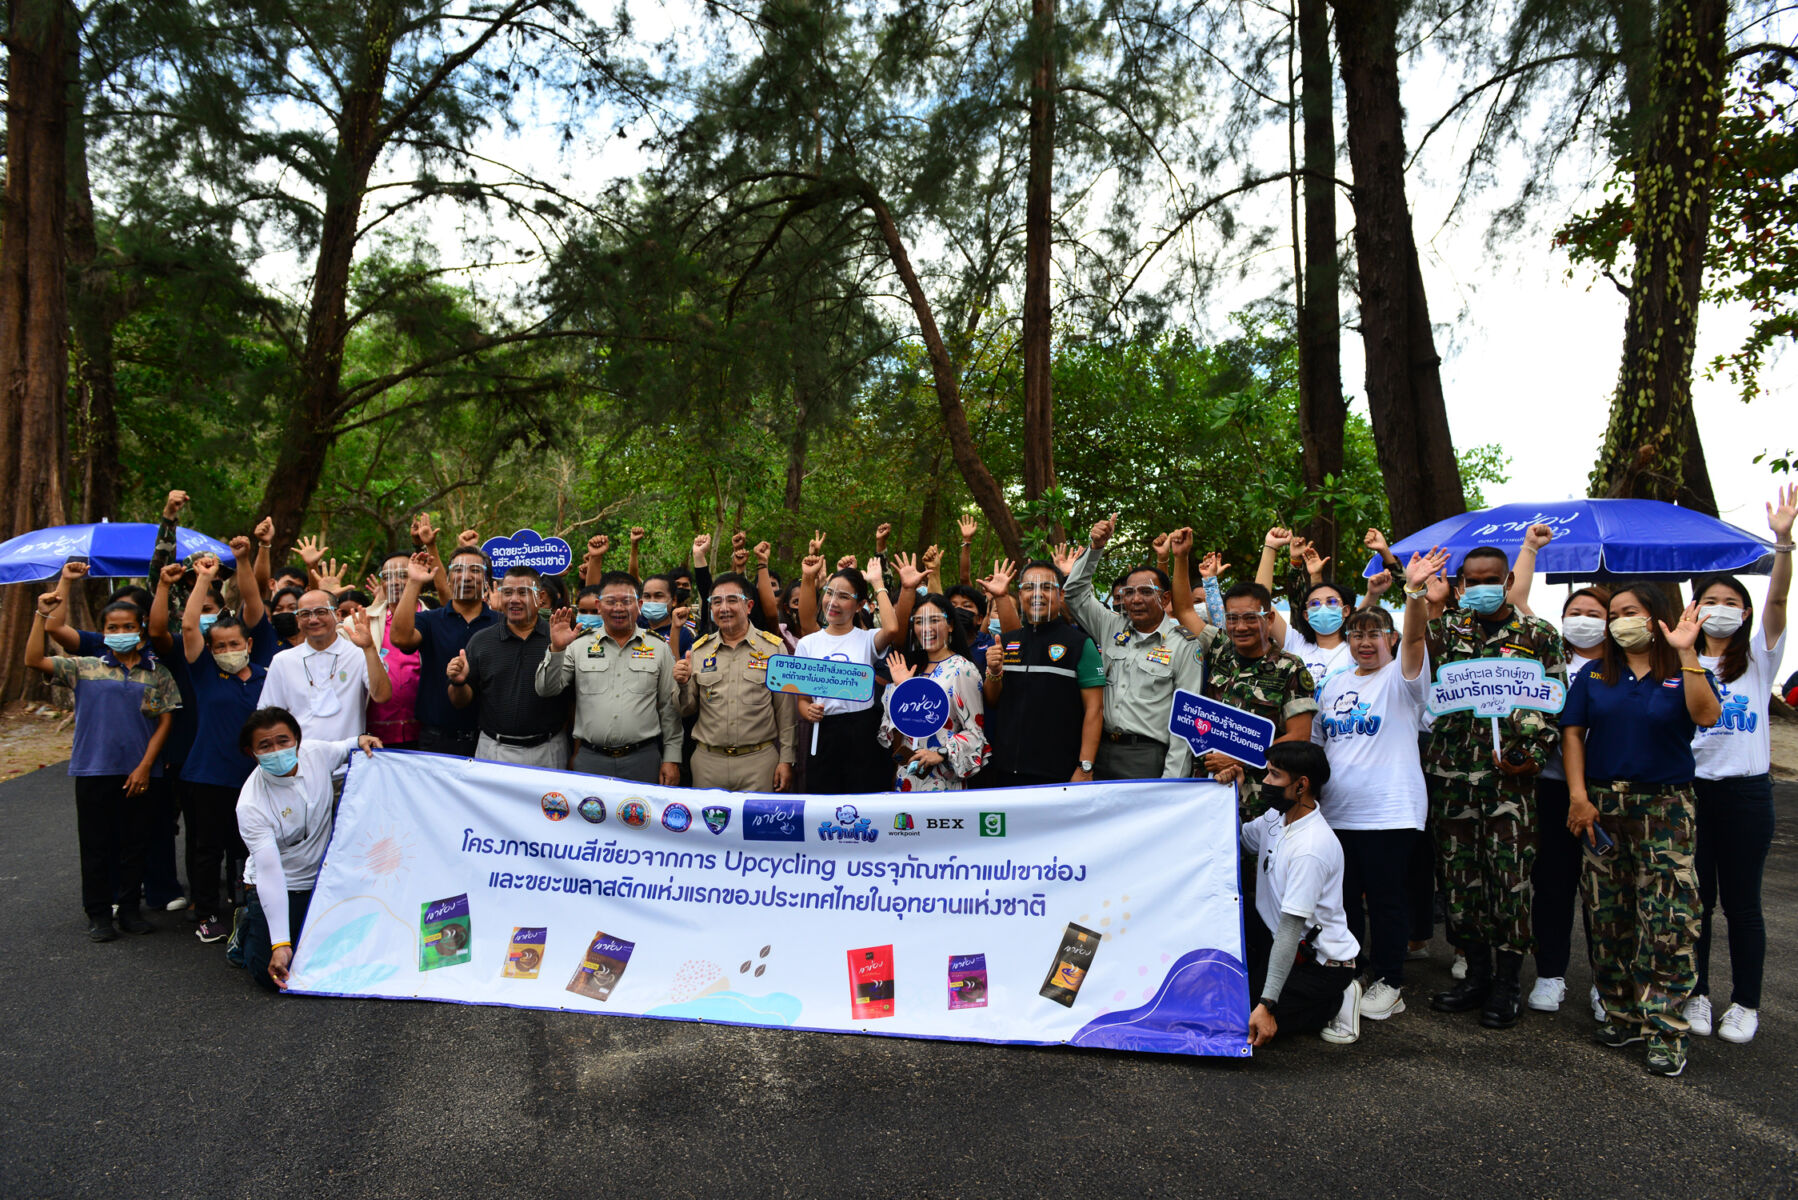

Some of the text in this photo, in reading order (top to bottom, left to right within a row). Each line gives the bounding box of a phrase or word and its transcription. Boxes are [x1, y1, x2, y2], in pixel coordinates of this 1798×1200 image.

[492, 543, 558, 556] ลดขยะวันละนิด
[776, 658, 807, 671] เขาช่อง
[1447, 666, 1535, 684] รักษ์ทะเล รักษ์เขา
[898, 694, 941, 713] เขาช่อง
[1183, 702, 1261, 738] รักษ์โลกต้องรู้จักลดขยะ
[1177, 714, 1264, 752] แต่ถ้า รัก นะคะ ไว้บอกเธอ
[752, 806, 795, 826] เขาช่อง
[926, 818, 964, 829] BEX
[461, 828, 1086, 886] โครงการถนนสีเขียวจากการ Upcycling บรรจุภัณฑ์กาแฟเขาช่อง
[488, 870, 1046, 920] และขยะพลาสติกแห่งแรกของประเทศไทยในอุทยานแห่งชาติ
[426, 902, 456, 920] เขาช่อง
